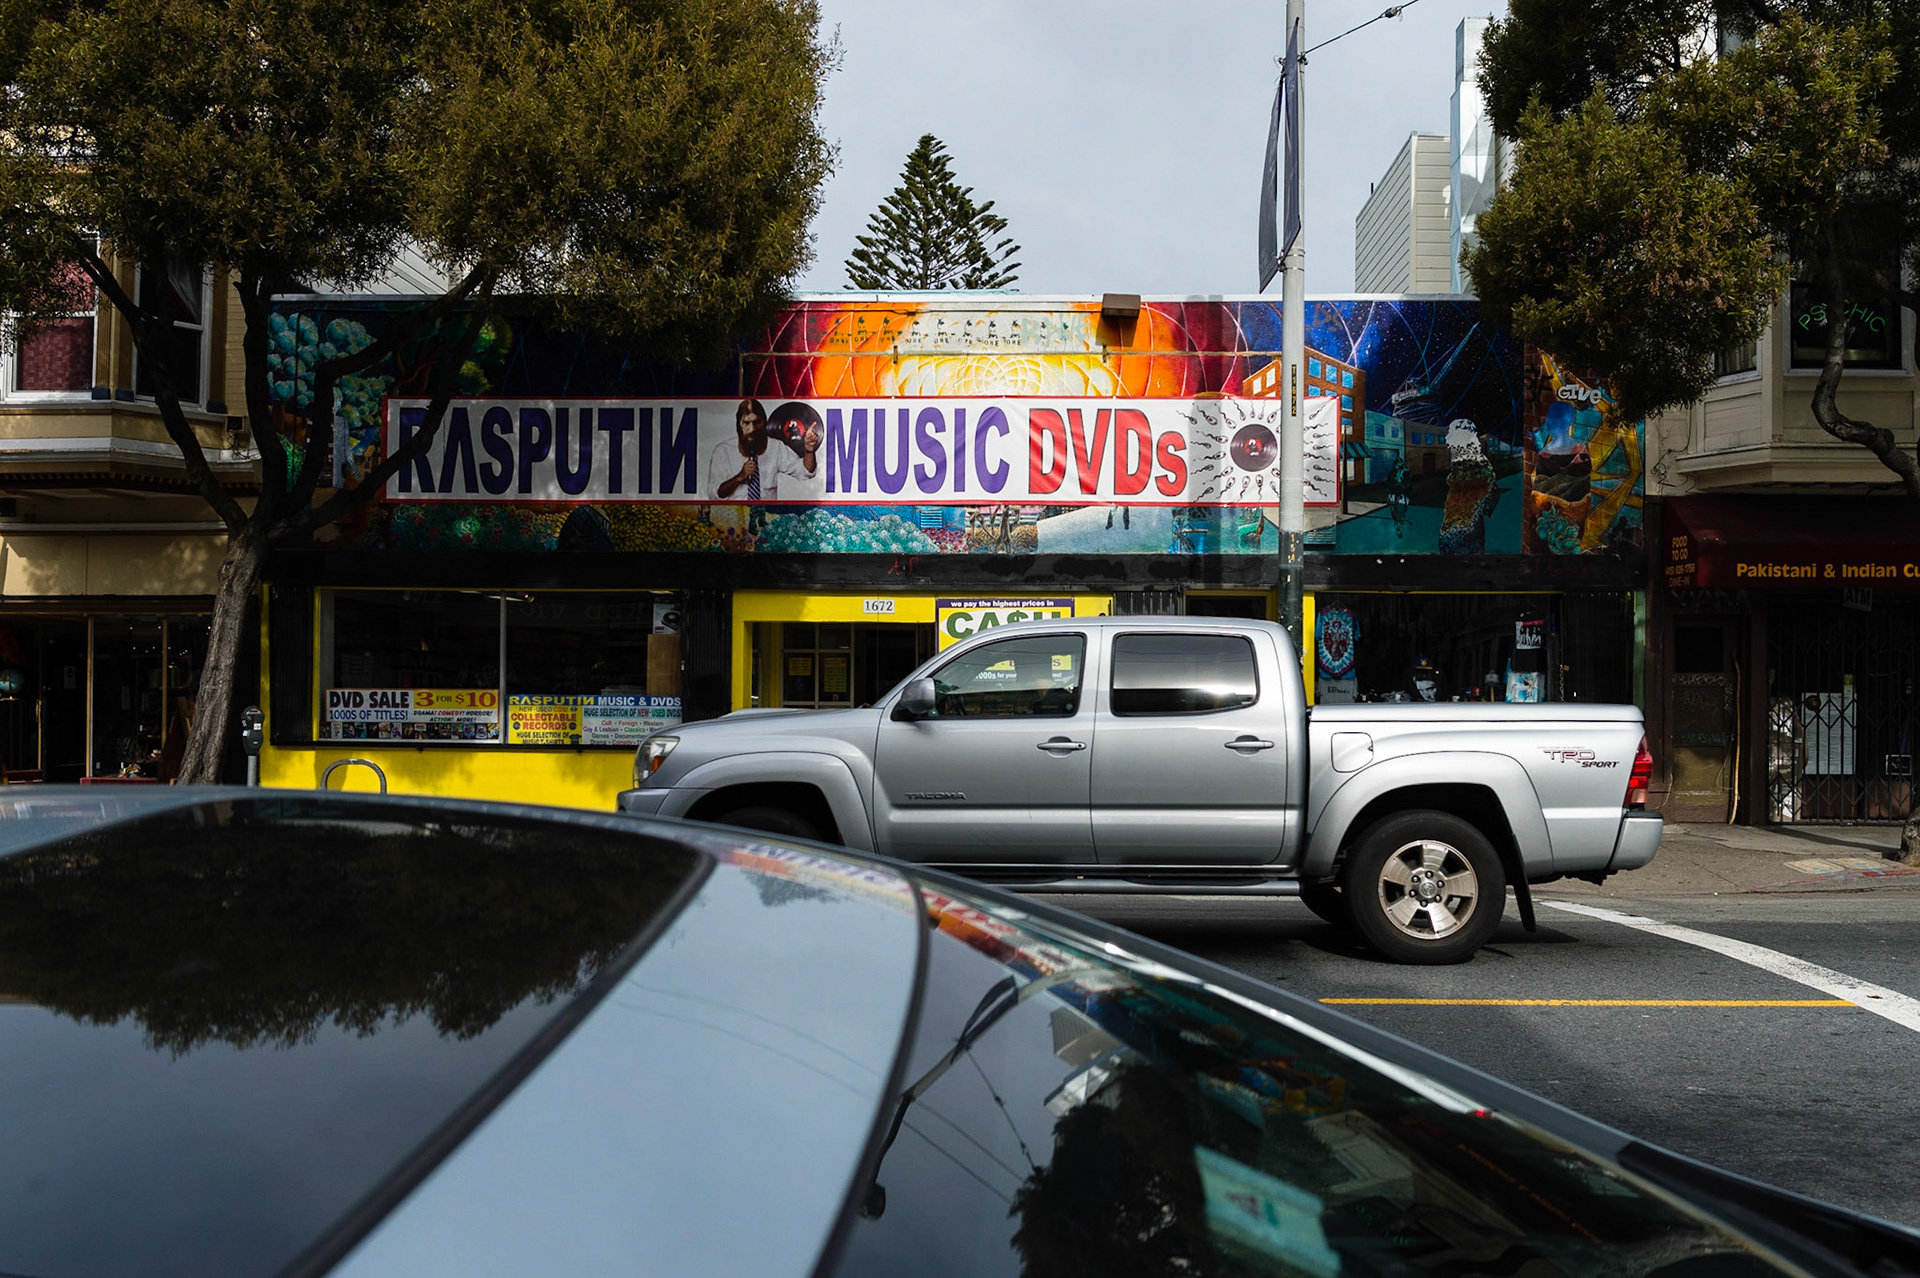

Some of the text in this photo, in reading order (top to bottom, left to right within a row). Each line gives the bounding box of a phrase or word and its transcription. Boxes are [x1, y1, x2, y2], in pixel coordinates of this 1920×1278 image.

[1798, 299, 1886, 333] PSHIC
[825, 406, 1010, 494] MUSIC
[1028, 408, 1187, 497] DVDs
[1672, 535, 1688, 548] FOOD
[1672, 549, 1679, 561] TO
[1736, 562, 1817, 578] Pakistani
[1823, 564, 1836, 578] &
[1842, 562, 1897, 578] Indian
[1844, 588, 1871, 606] ATM
[865, 601, 893, 611] 1672
[993, 600, 1020, 608] highest
[1022, 600, 1045, 608] prices
[329, 691, 364, 708] DVD
[369, 691, 409, 708] SALE
[415, 691, 434, 707] 3
[455, 691, 496, 707] $10
[598, 696, 635, 706] MUSIC
[639, 696, 647, 705] &
[651, 697, 681, 706] DVDS
[329, 710, 408, 720] 1000S OF TITLES!
[511, 713, 577, 721] COLLECTABLE
[584, 708, 598, 717] HUGE
[599, 708, 628, 717] SELECTION
[629, 708, 637, 717] OF
[523, 722, 567, 730] RECORDS
[1543, 750, 1596, 763] TRD
[904, 792, 968, 800] TACOMA
